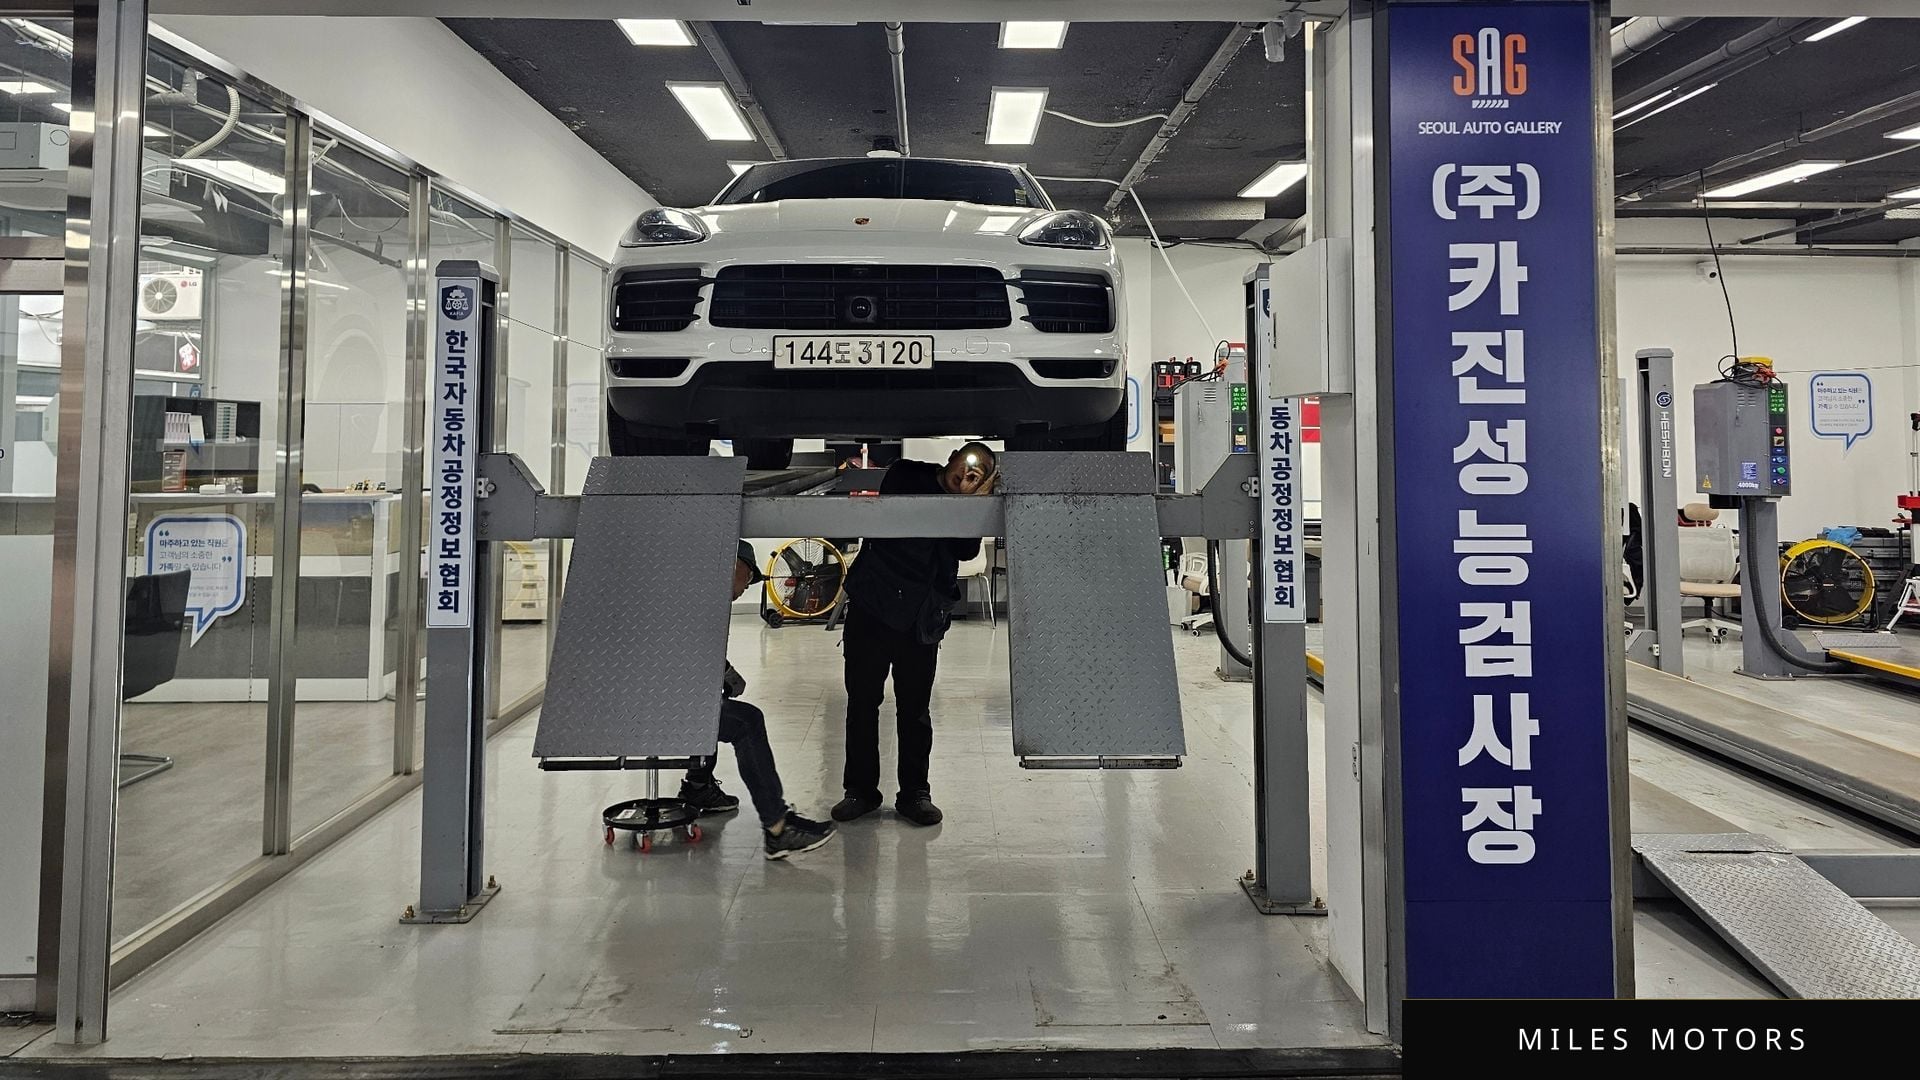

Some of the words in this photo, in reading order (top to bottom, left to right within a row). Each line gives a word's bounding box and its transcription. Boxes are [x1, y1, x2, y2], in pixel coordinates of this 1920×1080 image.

[1452, 27, 1527, 96] SAG
[1418, 121, 1460, 135] SEOUL
[1462, 121, 1501, 135] AUTO
[1504, 121, 1563, 135] GALLERY
[1660, 411, 1672, 478] HESHBON
[159, 539, 189, 549] 마주하고
[190, 539, 206, 548] 있는
